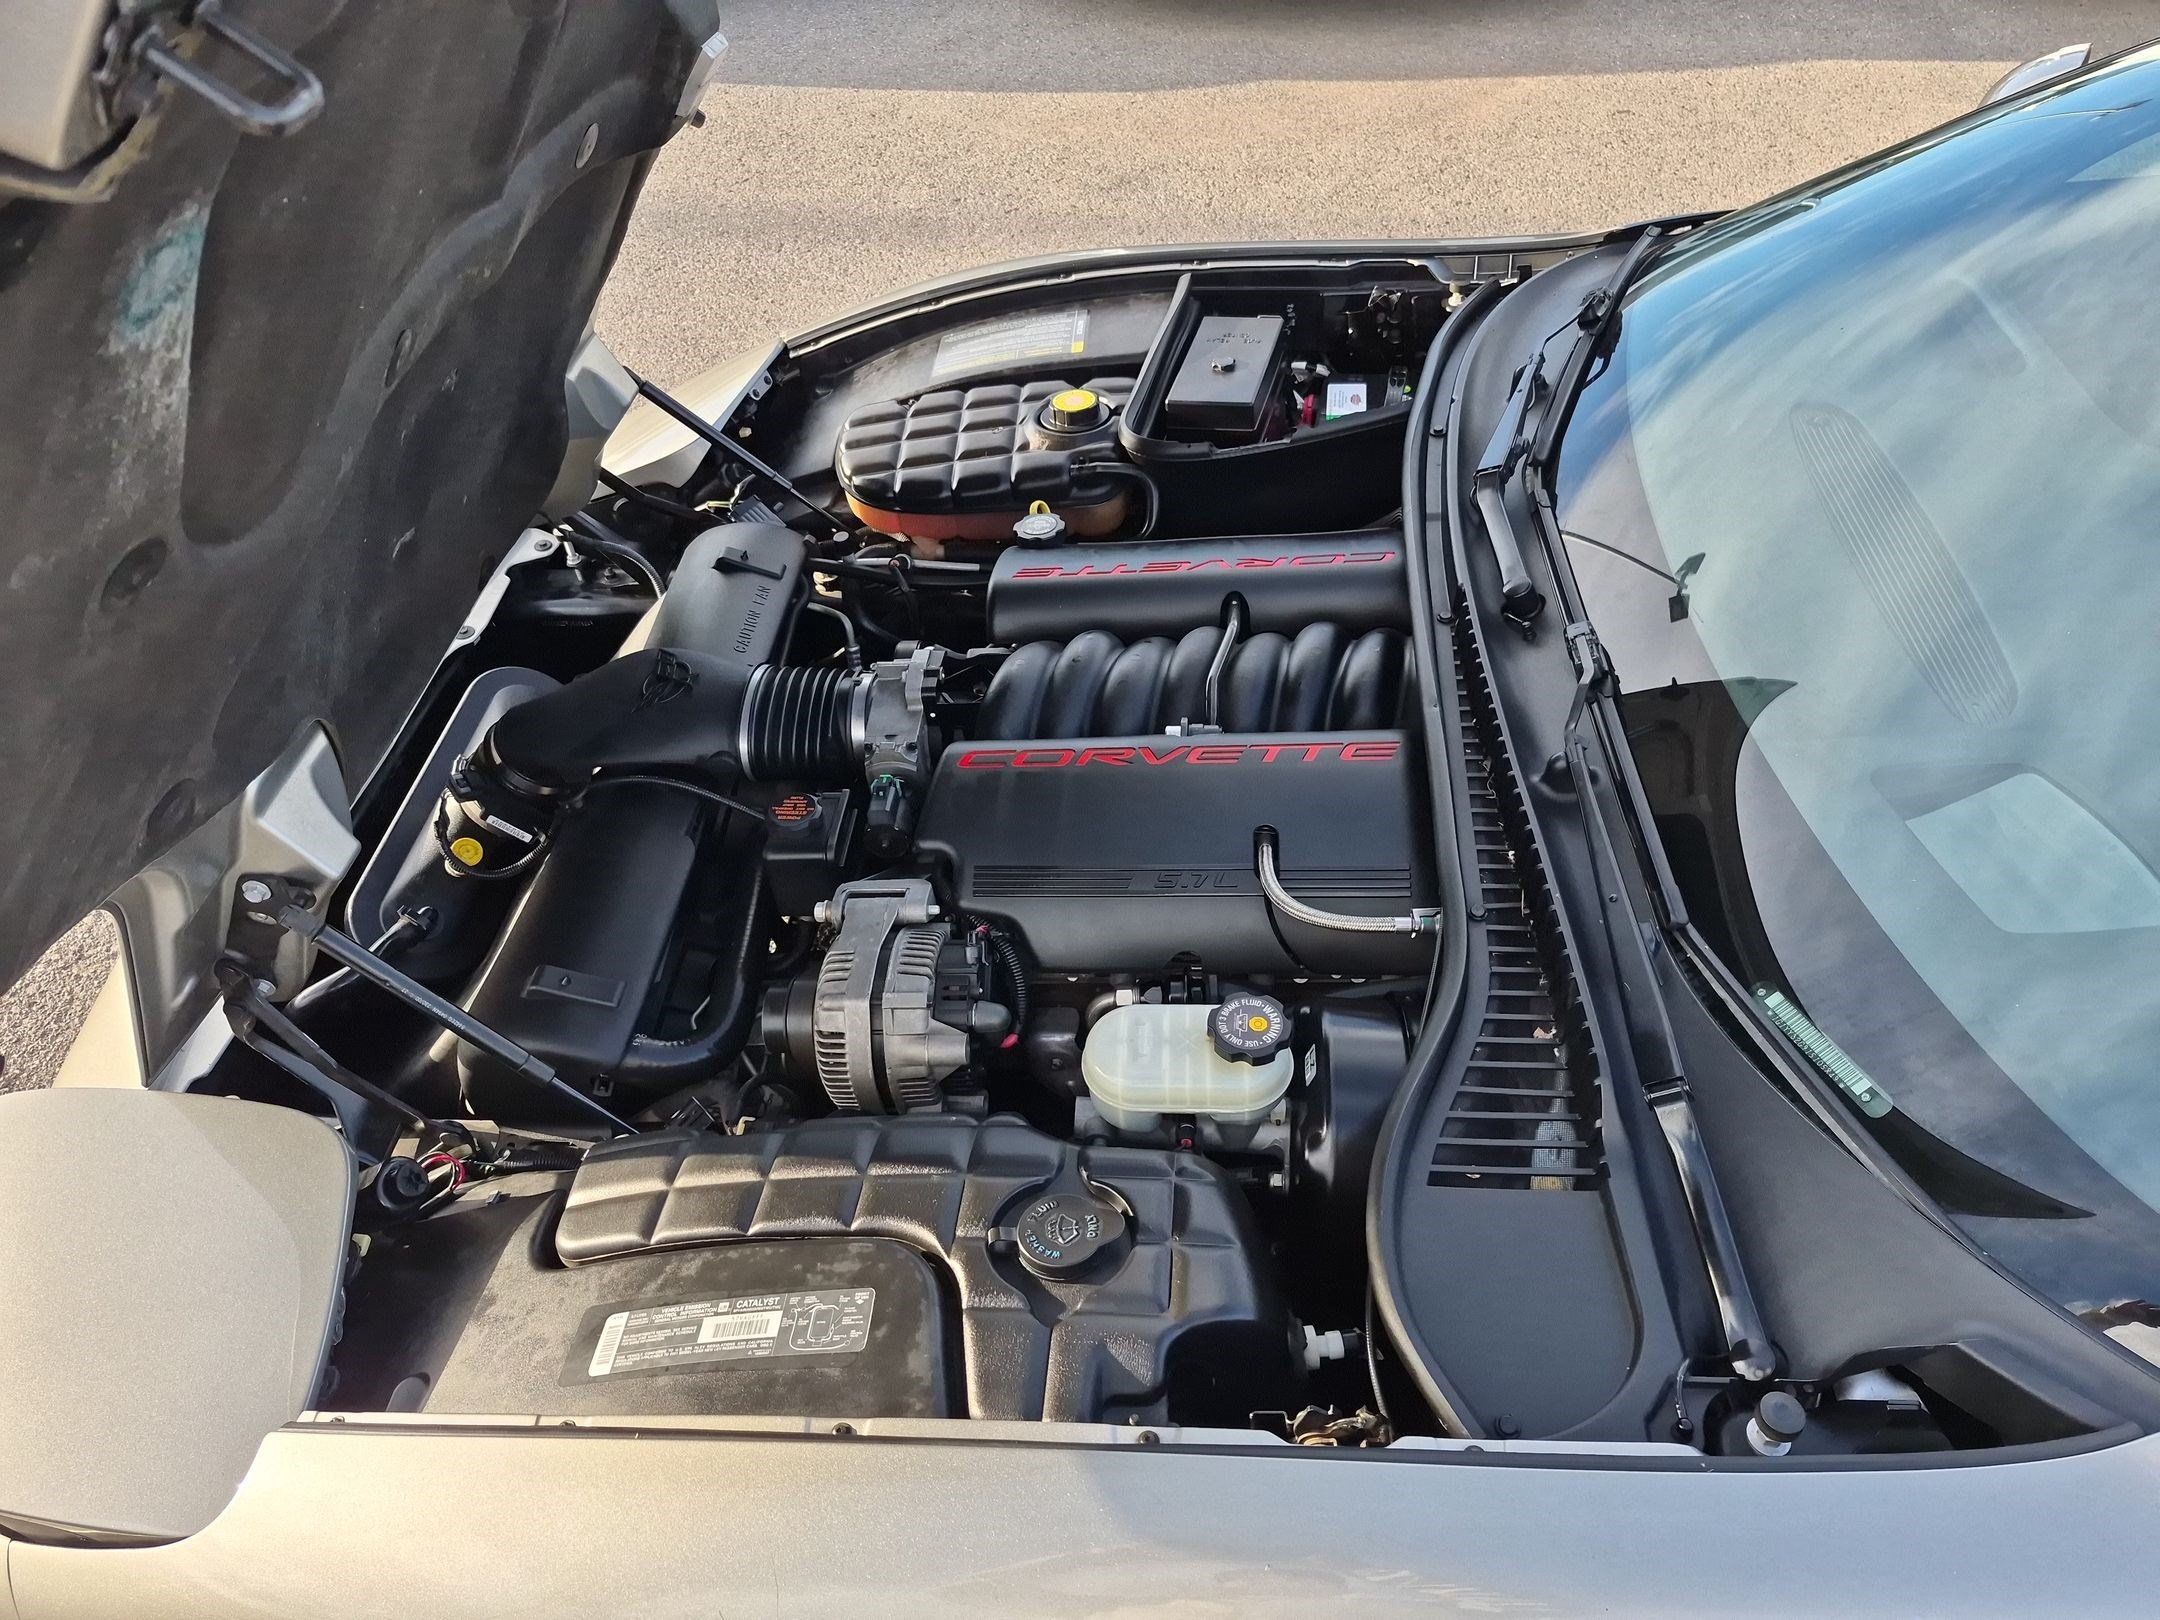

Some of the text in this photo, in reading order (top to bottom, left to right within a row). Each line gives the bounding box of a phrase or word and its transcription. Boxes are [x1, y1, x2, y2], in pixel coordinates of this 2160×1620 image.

[1013, 551, 1396, 578] CORVETTE
[734, 585, 770, 654] CAUTION FAN
[957, 741, 1401, 769] CORVETTE
[1154, 871, 1240, 890] 5.7L
[1222, 1000, 1241, 1016] BRAKE
[1262, 1004, 1281, 1044] WARNING
[1224, 1033, 1243, 1046] ONLY
[1084, 1214, 1100, 1239] ONLY
[736, 1297, 780, 1308] CATALYST
